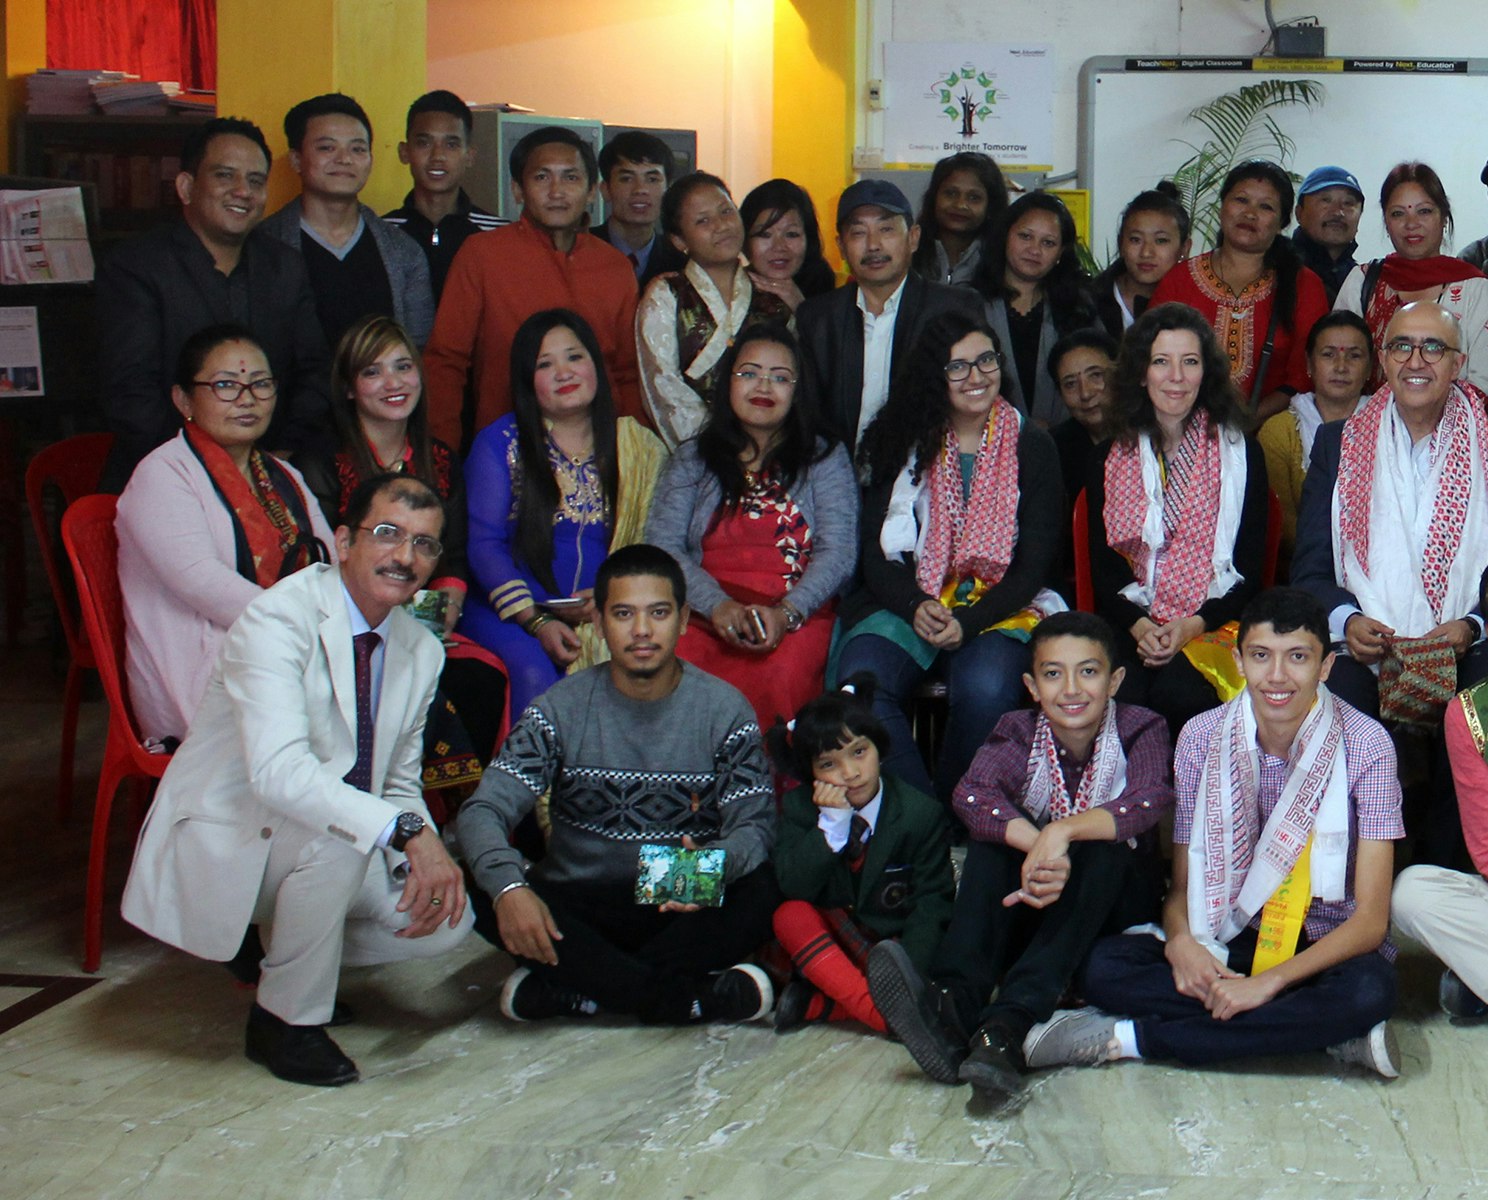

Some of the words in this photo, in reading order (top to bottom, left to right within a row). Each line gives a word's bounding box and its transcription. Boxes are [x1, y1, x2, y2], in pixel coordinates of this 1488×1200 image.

[1181, 60, 1205, 68] Digital
[1385, 61, 1394, 69] by
[943, 142, 979, 152] Brighter
[983, 142, 1027, 151] Tomorrow
